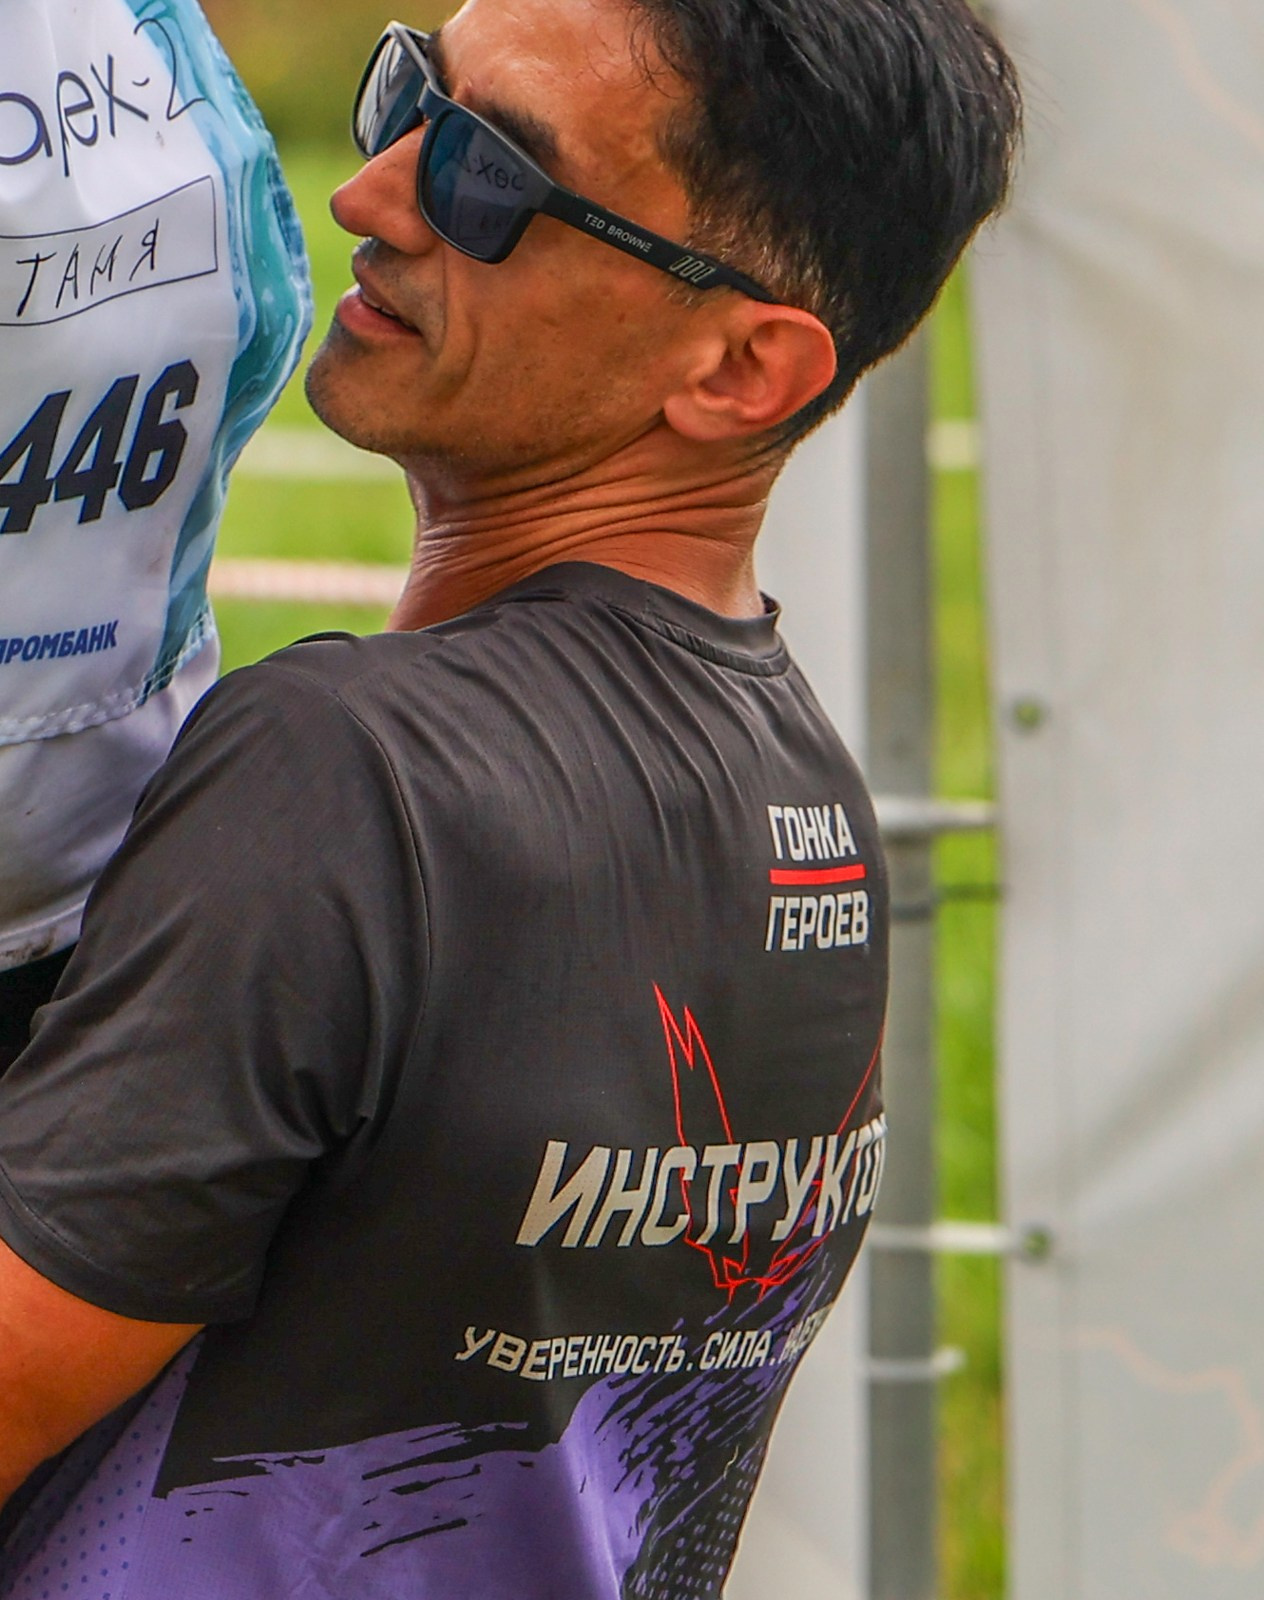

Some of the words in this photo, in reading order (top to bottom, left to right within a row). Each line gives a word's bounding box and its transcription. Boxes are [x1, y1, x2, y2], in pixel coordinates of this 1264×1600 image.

[584, 212, 606, 230] TED
[606, 224, 653, 253] BROWNE
[767, 803, 858, 861] ГОНКА
[764, 889, 870, 952] ГЕРОЕВ
[515, 1112, 888, 1248] ИНСТРУКТО
